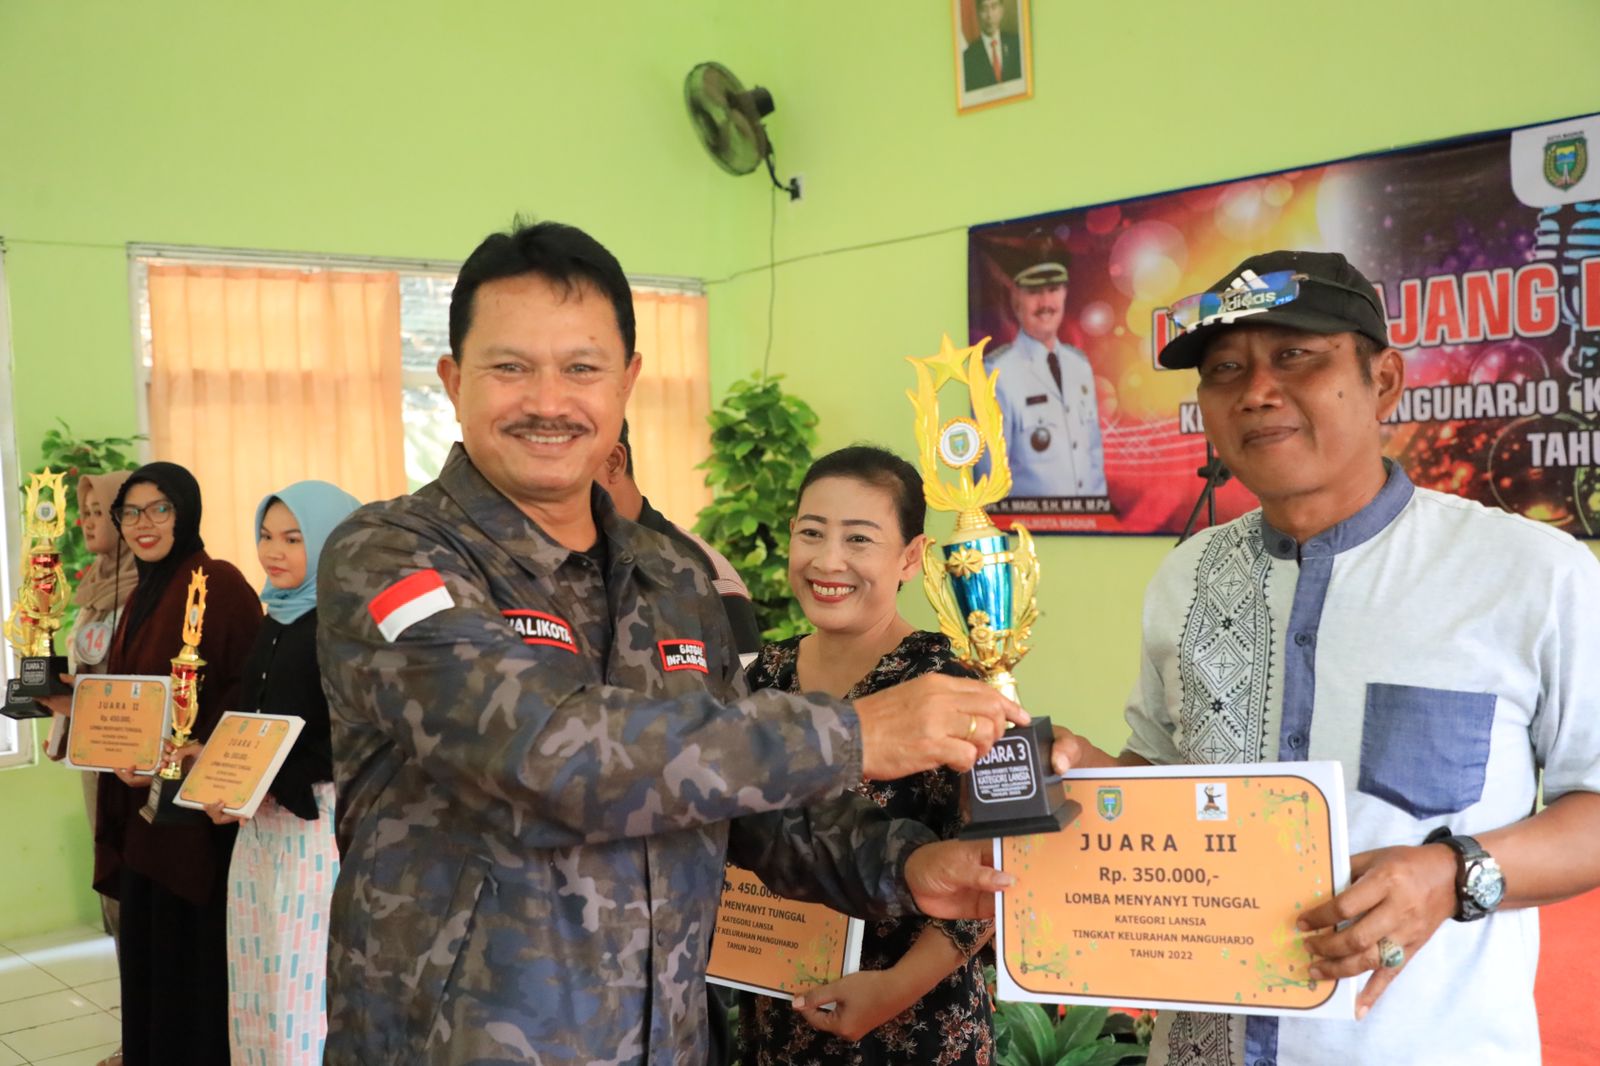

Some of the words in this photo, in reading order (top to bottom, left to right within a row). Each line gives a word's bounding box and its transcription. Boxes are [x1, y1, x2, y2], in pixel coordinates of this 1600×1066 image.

[1375, 263, 1560, 348] JANG
[1381, 380, 1560, 423] NGUHARJO
[1016, 743, 1027, 761] 3
[1080, 833, 1178, 852] JUARA
[1204, 834, 1238, 853] III
[1099, 867, 1128, 885] Rp.
[1132, 867, 1220, 886] 350.000,-
[1065, 893, 1111, 906] LOMBA
[1114, 894, 1188, 908] MENYANYI
[1192, 896, 1260, 910] TUNGGAL
[724, 900, 766, 916] MENYANYI
[768, 907, 807, 923] TUNGGAL
[722, 915, 751, 926] KATEGORI
[752, 921, 774, 931] LANSIA
[1114, 915, 1166, 926] KATEGORI
[1168, 916, 1207, 927] LANSIA
[722, 928, 756, 940] KELURAHAN
[757, 934, 799, 949] MANGUHARJO
[1073, 930, 1115, 941] TINGKAT
[1118, 931, 1178, 943] KELURAHAN
[1181, 933, 1255, 946] MANGUHARJO
[727, 942, 747, 951] TAHUN
[747, 945, 762, 955] 2022
[1130, 949, 1165, 960] TAHUN
[1168, 949, 1193, 960] 2022
